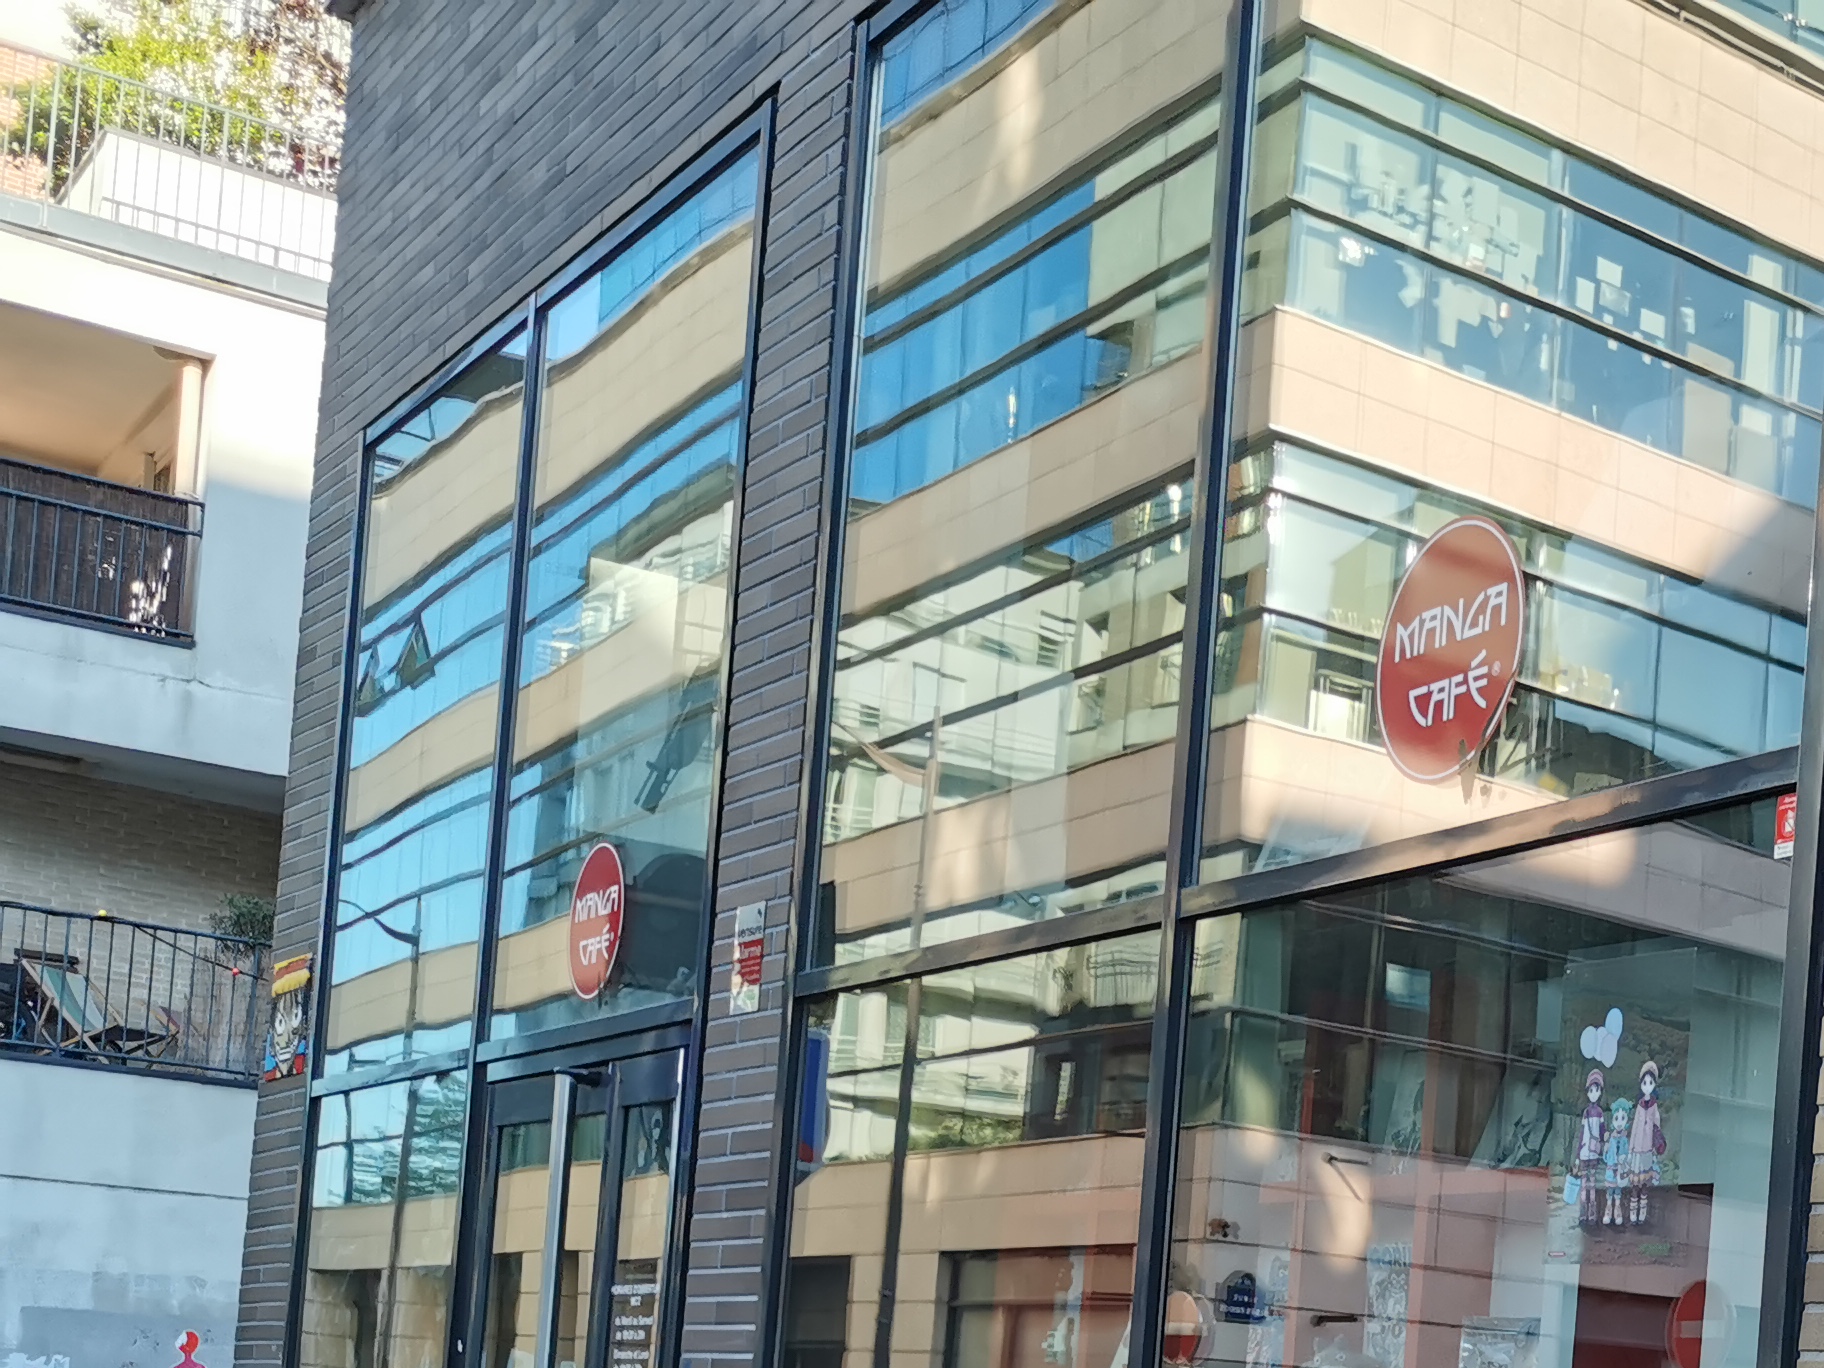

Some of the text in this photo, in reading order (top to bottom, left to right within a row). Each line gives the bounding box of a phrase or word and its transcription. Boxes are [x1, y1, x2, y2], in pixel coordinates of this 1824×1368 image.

[1394, 582, 1508, 663] MANGA
[1408, 649, 1488, 728] CAFÉ
[575, 885, 619, 923] MANGA
[580, 923, 610, 965] CAFÉ
